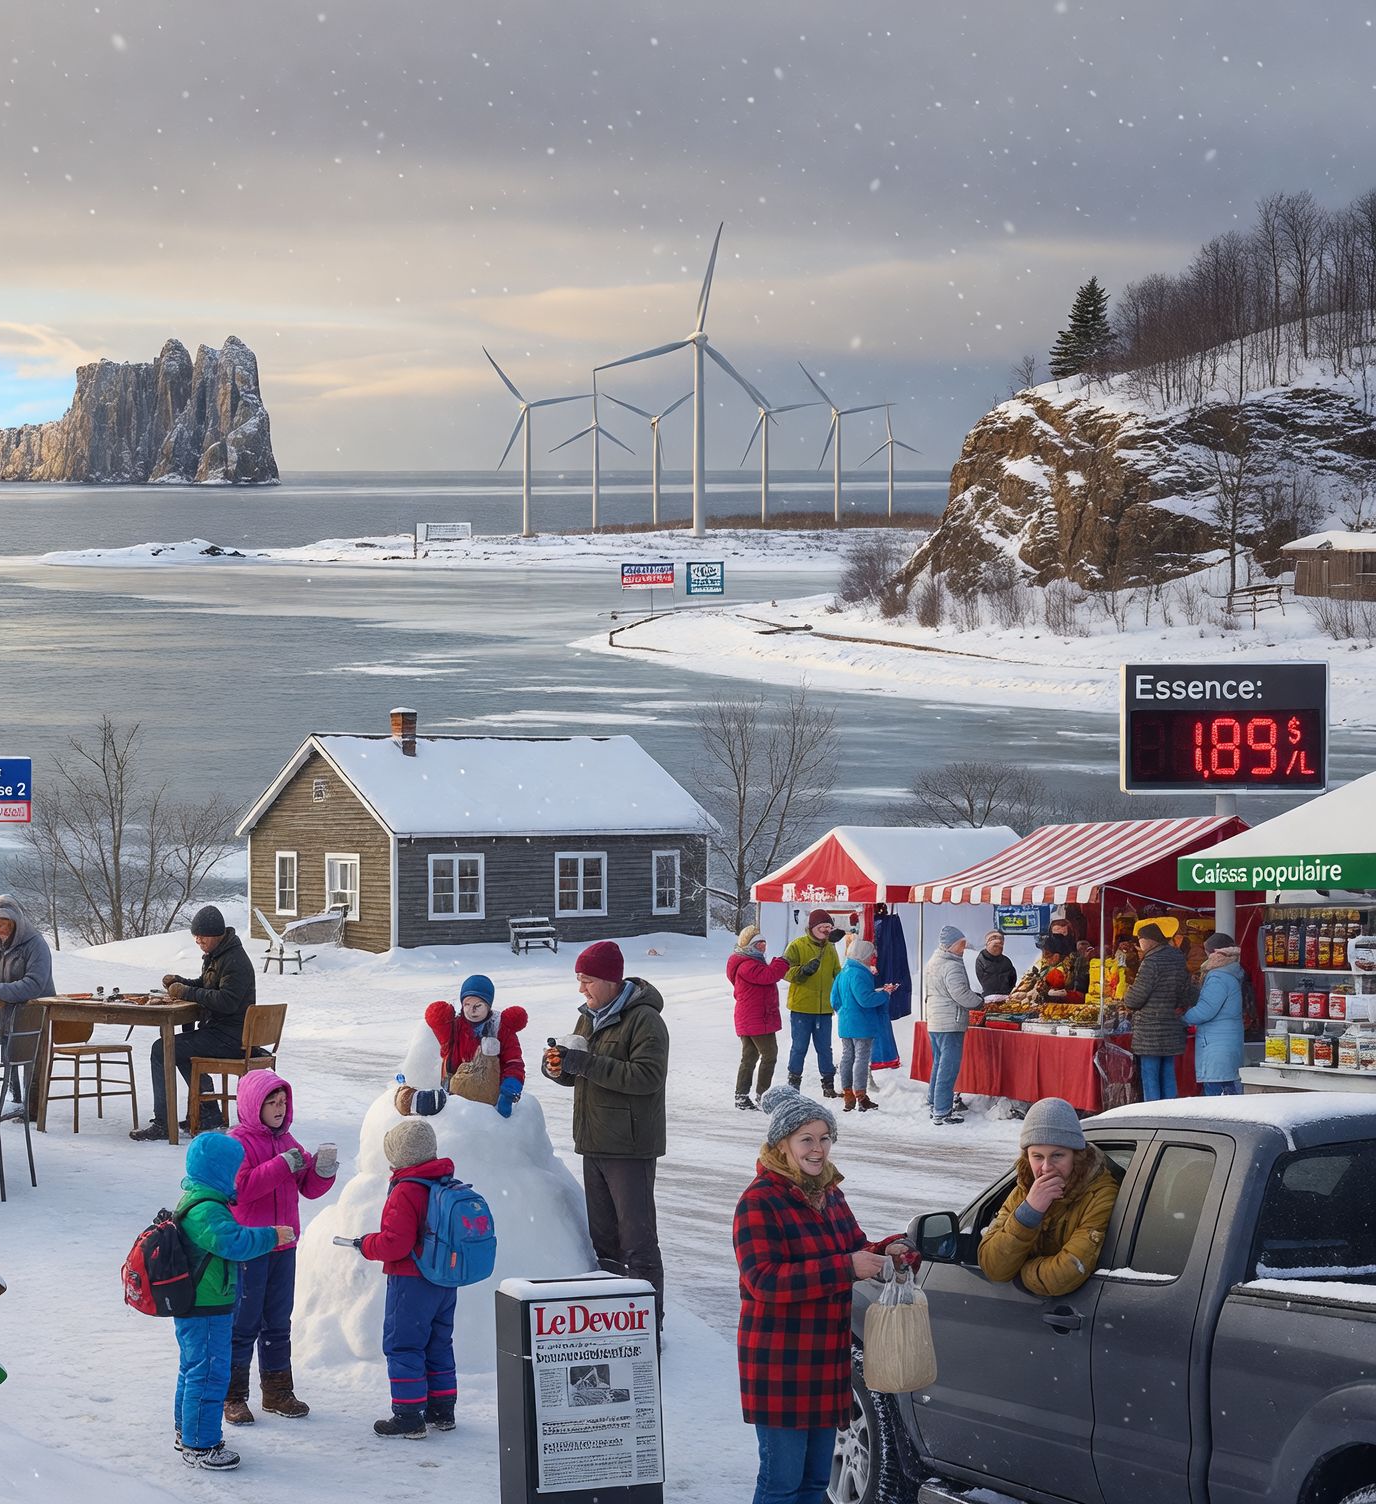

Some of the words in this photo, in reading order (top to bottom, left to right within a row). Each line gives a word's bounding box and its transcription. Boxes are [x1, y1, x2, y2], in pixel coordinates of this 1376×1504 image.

[1135, 674, 1263, 700] Essence:
[1194, 717, 1277, 779] 1,89
[16, 782, 26, 796] 2
[1252, 858, 1342, 888] populaire
[533, 1306, 566, 1336] Le
[566, 1302, 650, 1334] Devoir
